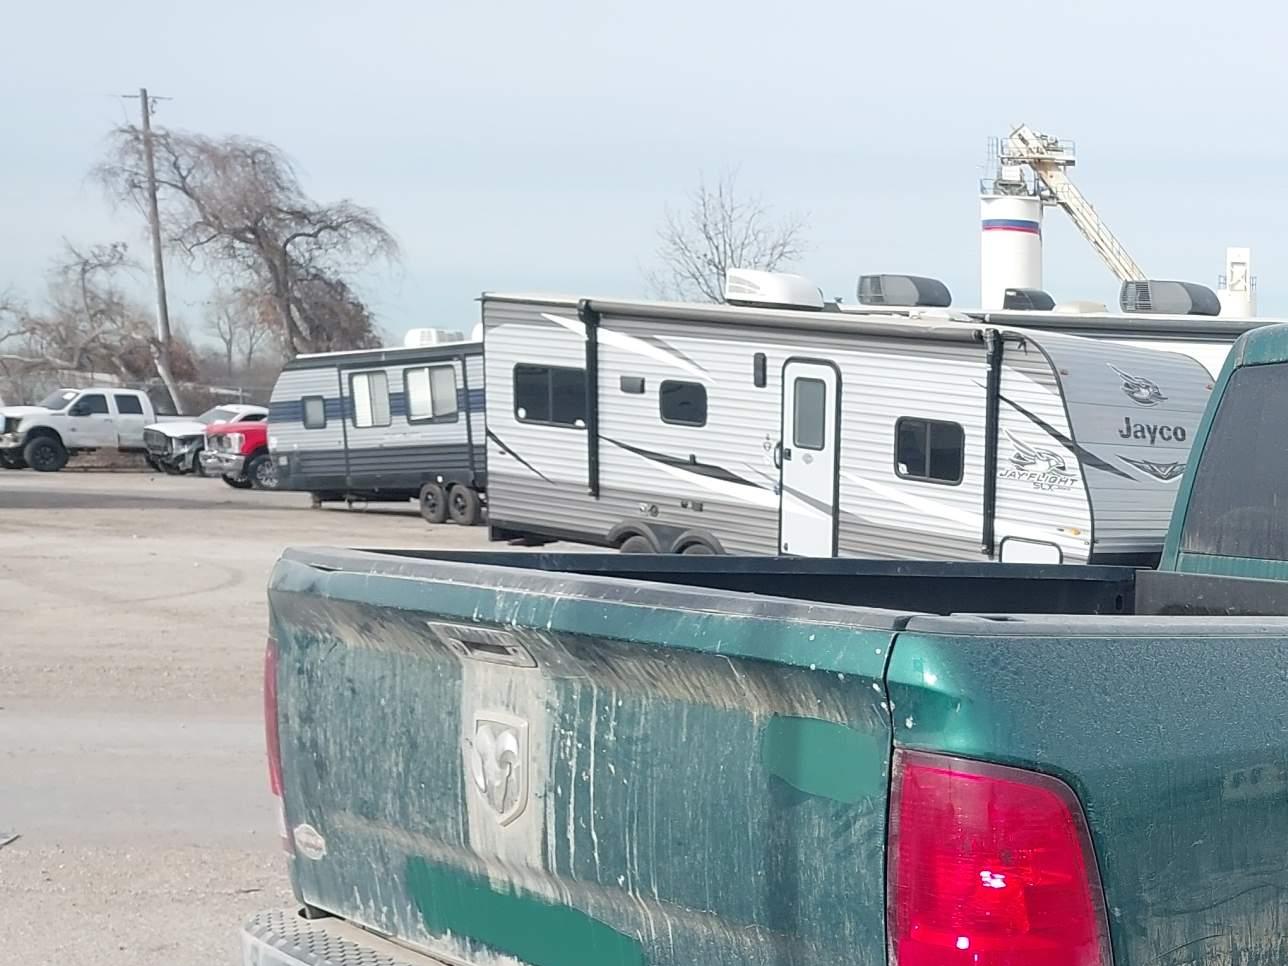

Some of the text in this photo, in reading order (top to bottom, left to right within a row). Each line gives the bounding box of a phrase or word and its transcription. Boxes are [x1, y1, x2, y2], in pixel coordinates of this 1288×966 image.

[1118, 416, 1187, 445] Jayco
[999, 469, 1078, 486] JAY FLIGHT
